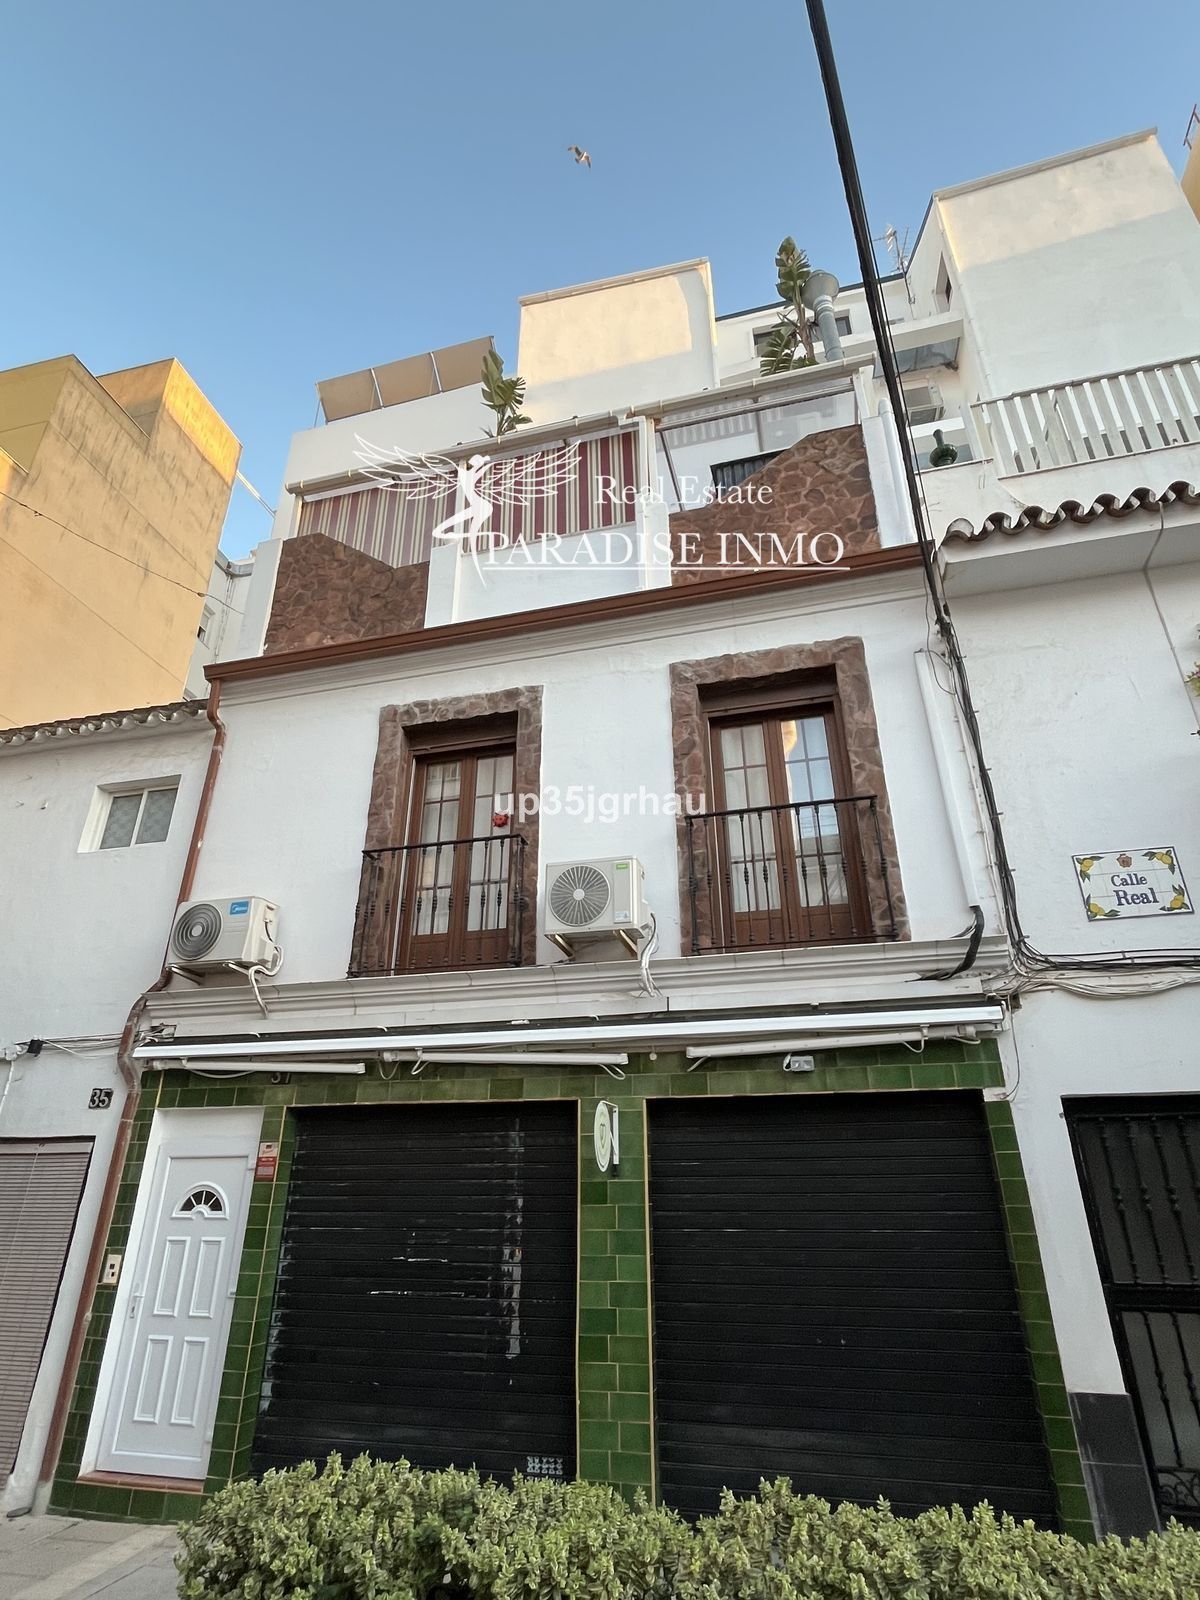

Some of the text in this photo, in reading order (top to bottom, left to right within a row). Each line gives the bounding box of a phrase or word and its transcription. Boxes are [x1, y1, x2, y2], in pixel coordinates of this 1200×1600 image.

[1110, 873, 1148, 888] Calle
[1113, 887, 1160, 906] Real
[90, 1089, 112, 1107] 35
